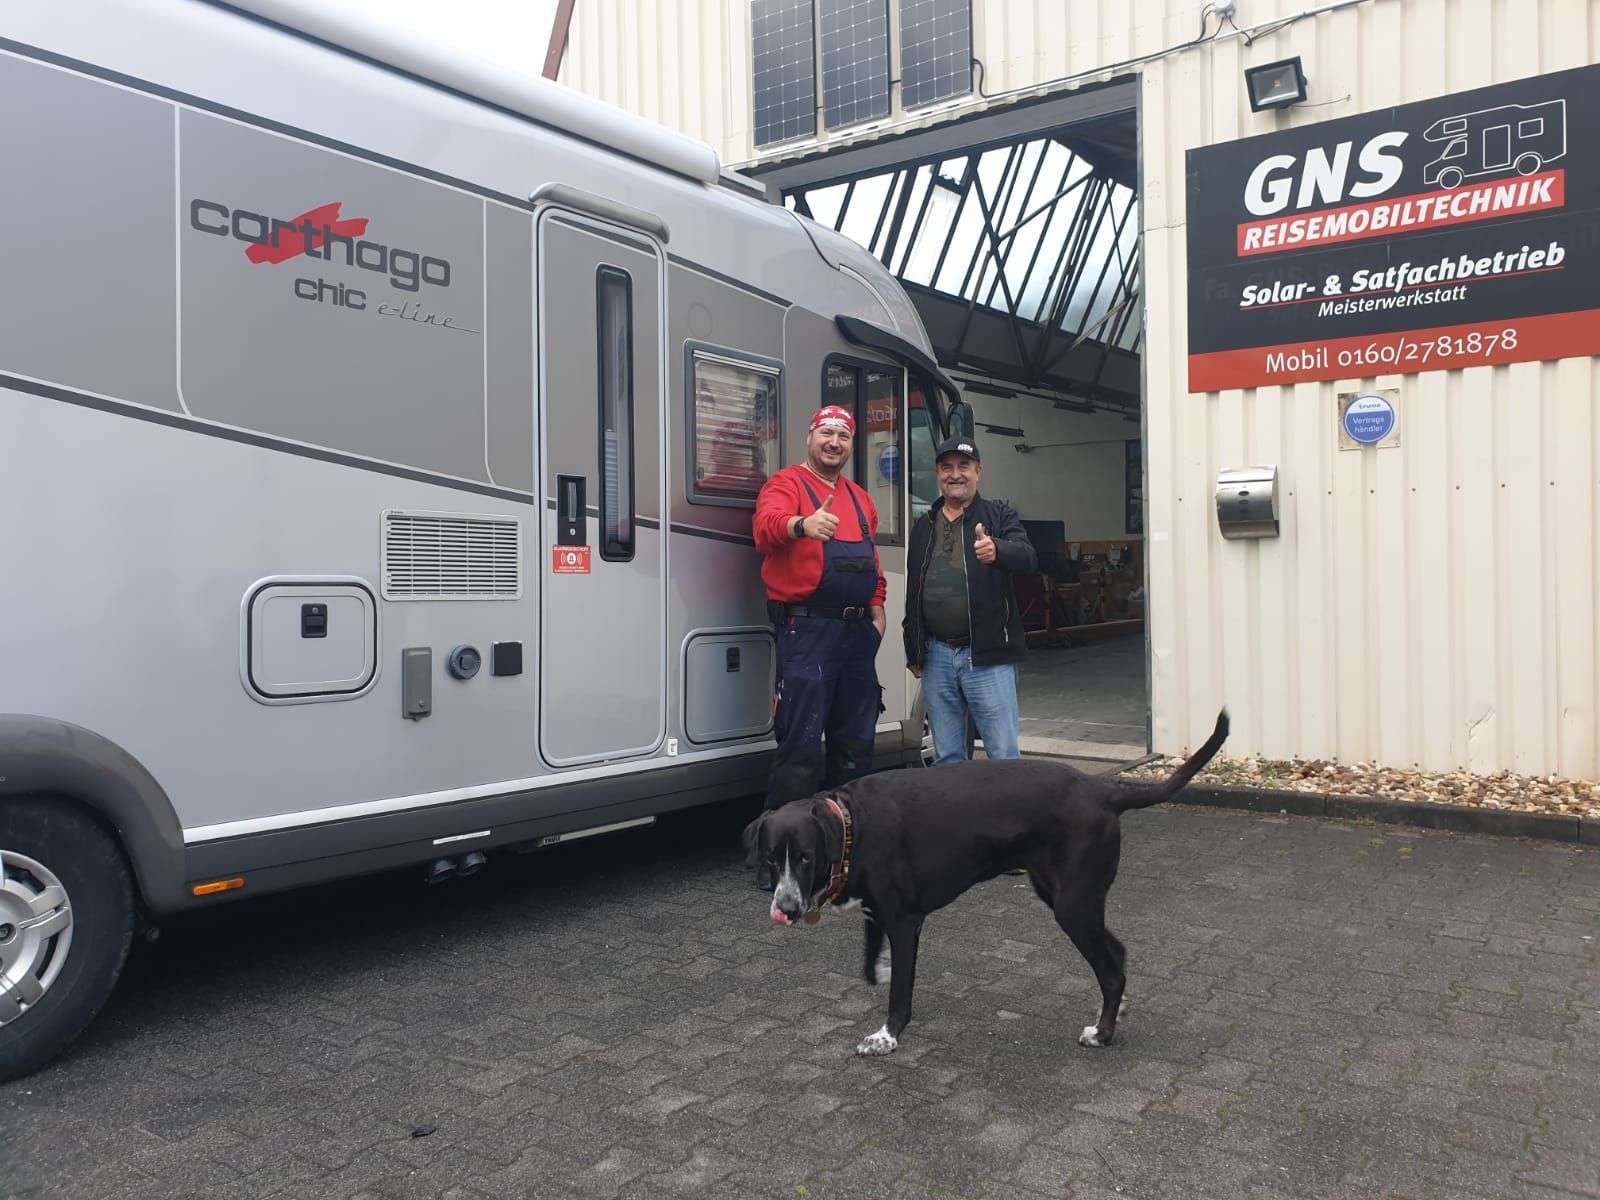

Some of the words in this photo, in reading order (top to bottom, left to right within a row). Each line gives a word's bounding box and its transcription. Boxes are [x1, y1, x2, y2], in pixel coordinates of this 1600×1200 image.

[1244, 130, 1410, 216] GNS
[1243, 176, 1556, 251] REISEMOBILTECHNIK
[190, 198, 451, 293] carthago
[1239, 280, 1316, 307] Solar-
[1322, 274, 1343, 296] &
[1349, 241, 1566, 294] Satfachbetrieb
[1317, 284, 1468, 318] Meisterwerkstatt
[294, 277, 367, 311] chic
[377, 300, 481, 333] e-line
[1266, 347, 1329, 374] Mobil
[1337, 328, 1518, 367] 0160/2781878
[1352, 416, 1385, 425] Vertrags
[1354, 425, 1383, 433] händler
